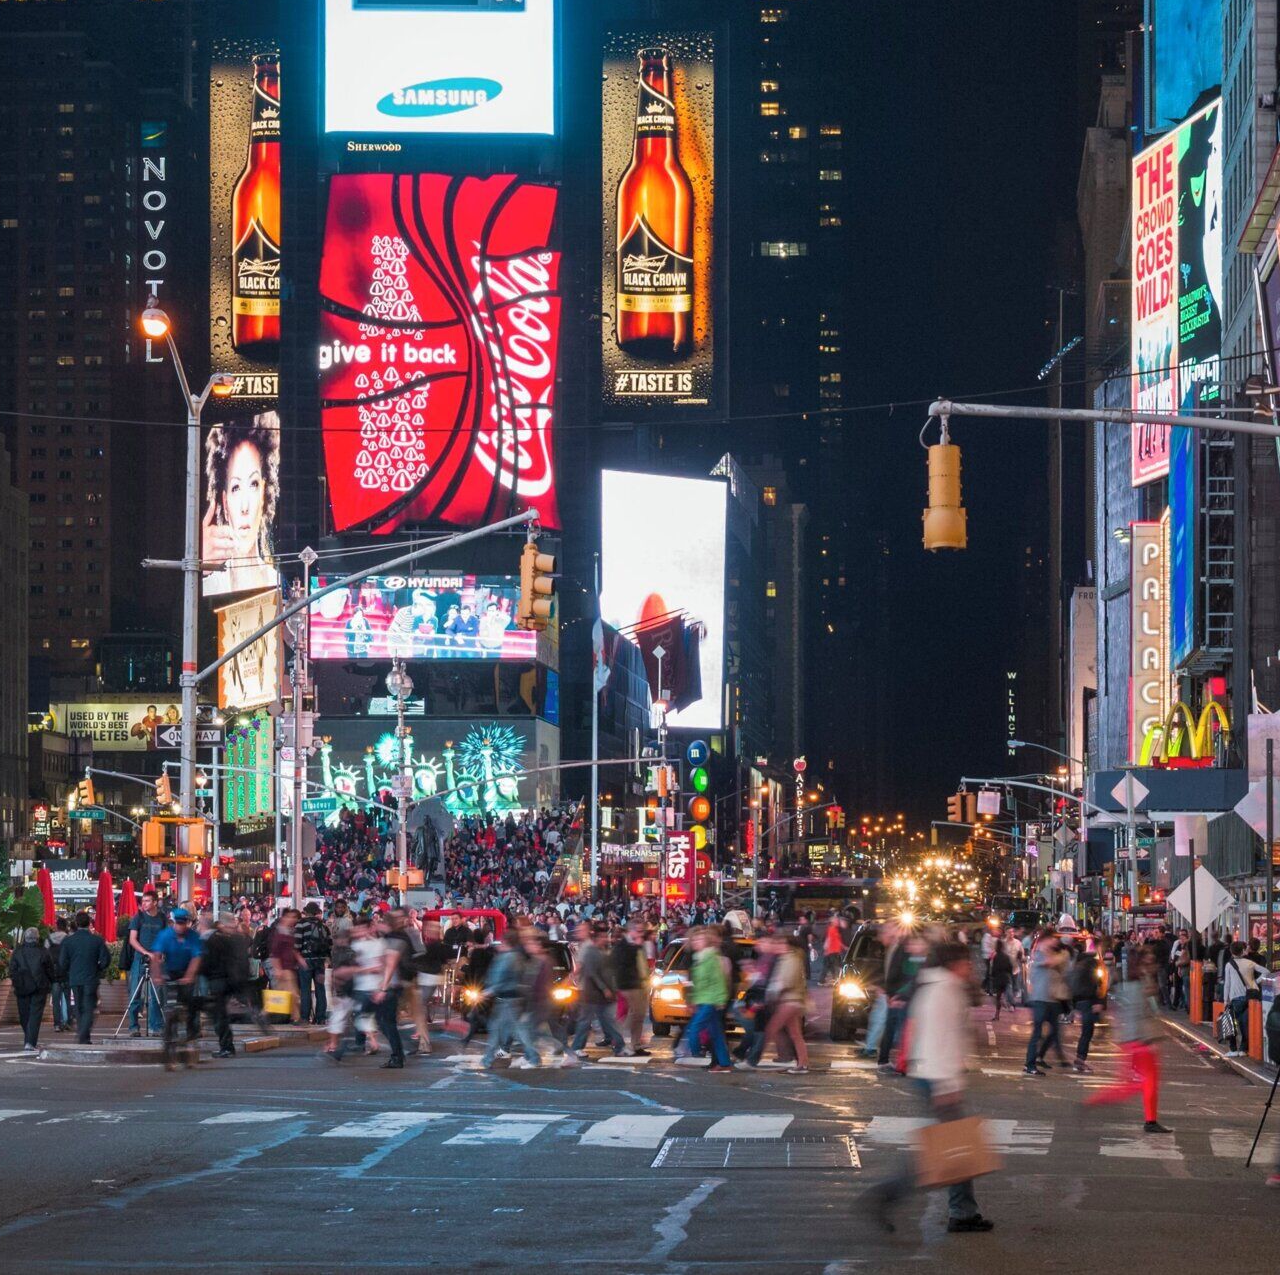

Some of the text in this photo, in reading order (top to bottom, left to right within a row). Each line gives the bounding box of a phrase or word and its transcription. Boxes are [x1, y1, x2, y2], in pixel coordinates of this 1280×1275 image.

[392, 88, 488, 108] SAMSUNG
[347, 140, 402, 152] SHERWOOD
[1136, 142, 1173, 210] THE
[1136, 196, 1173, 242] CROWD
[142, 156, 166, 364] NOVOTL
[1136, 227, 1173, 282] GOES
[240, 277, 265, 290] BLACK
[624, 272, 687, 287] BLACK CROWN
[1136, 266, 1175, 321] WILD!
[319, 339, 457, 369] give it back
[615, 372, 692, 392] #TASTE IS
[408, 577, 463, 588] HYUNDAI
[1140, 542, 1161, 738] PALACE
[70, 711, 129, 721] USED BY THE
[1006, 671, 1017, 756] WLLINGTN
[70, 721, 128, 729] WORLD'S BEST
[195, 729, 216, 741] WAY
[303, 801, 331, 810] Broadway
[668, 834, 689, 880] tkts
